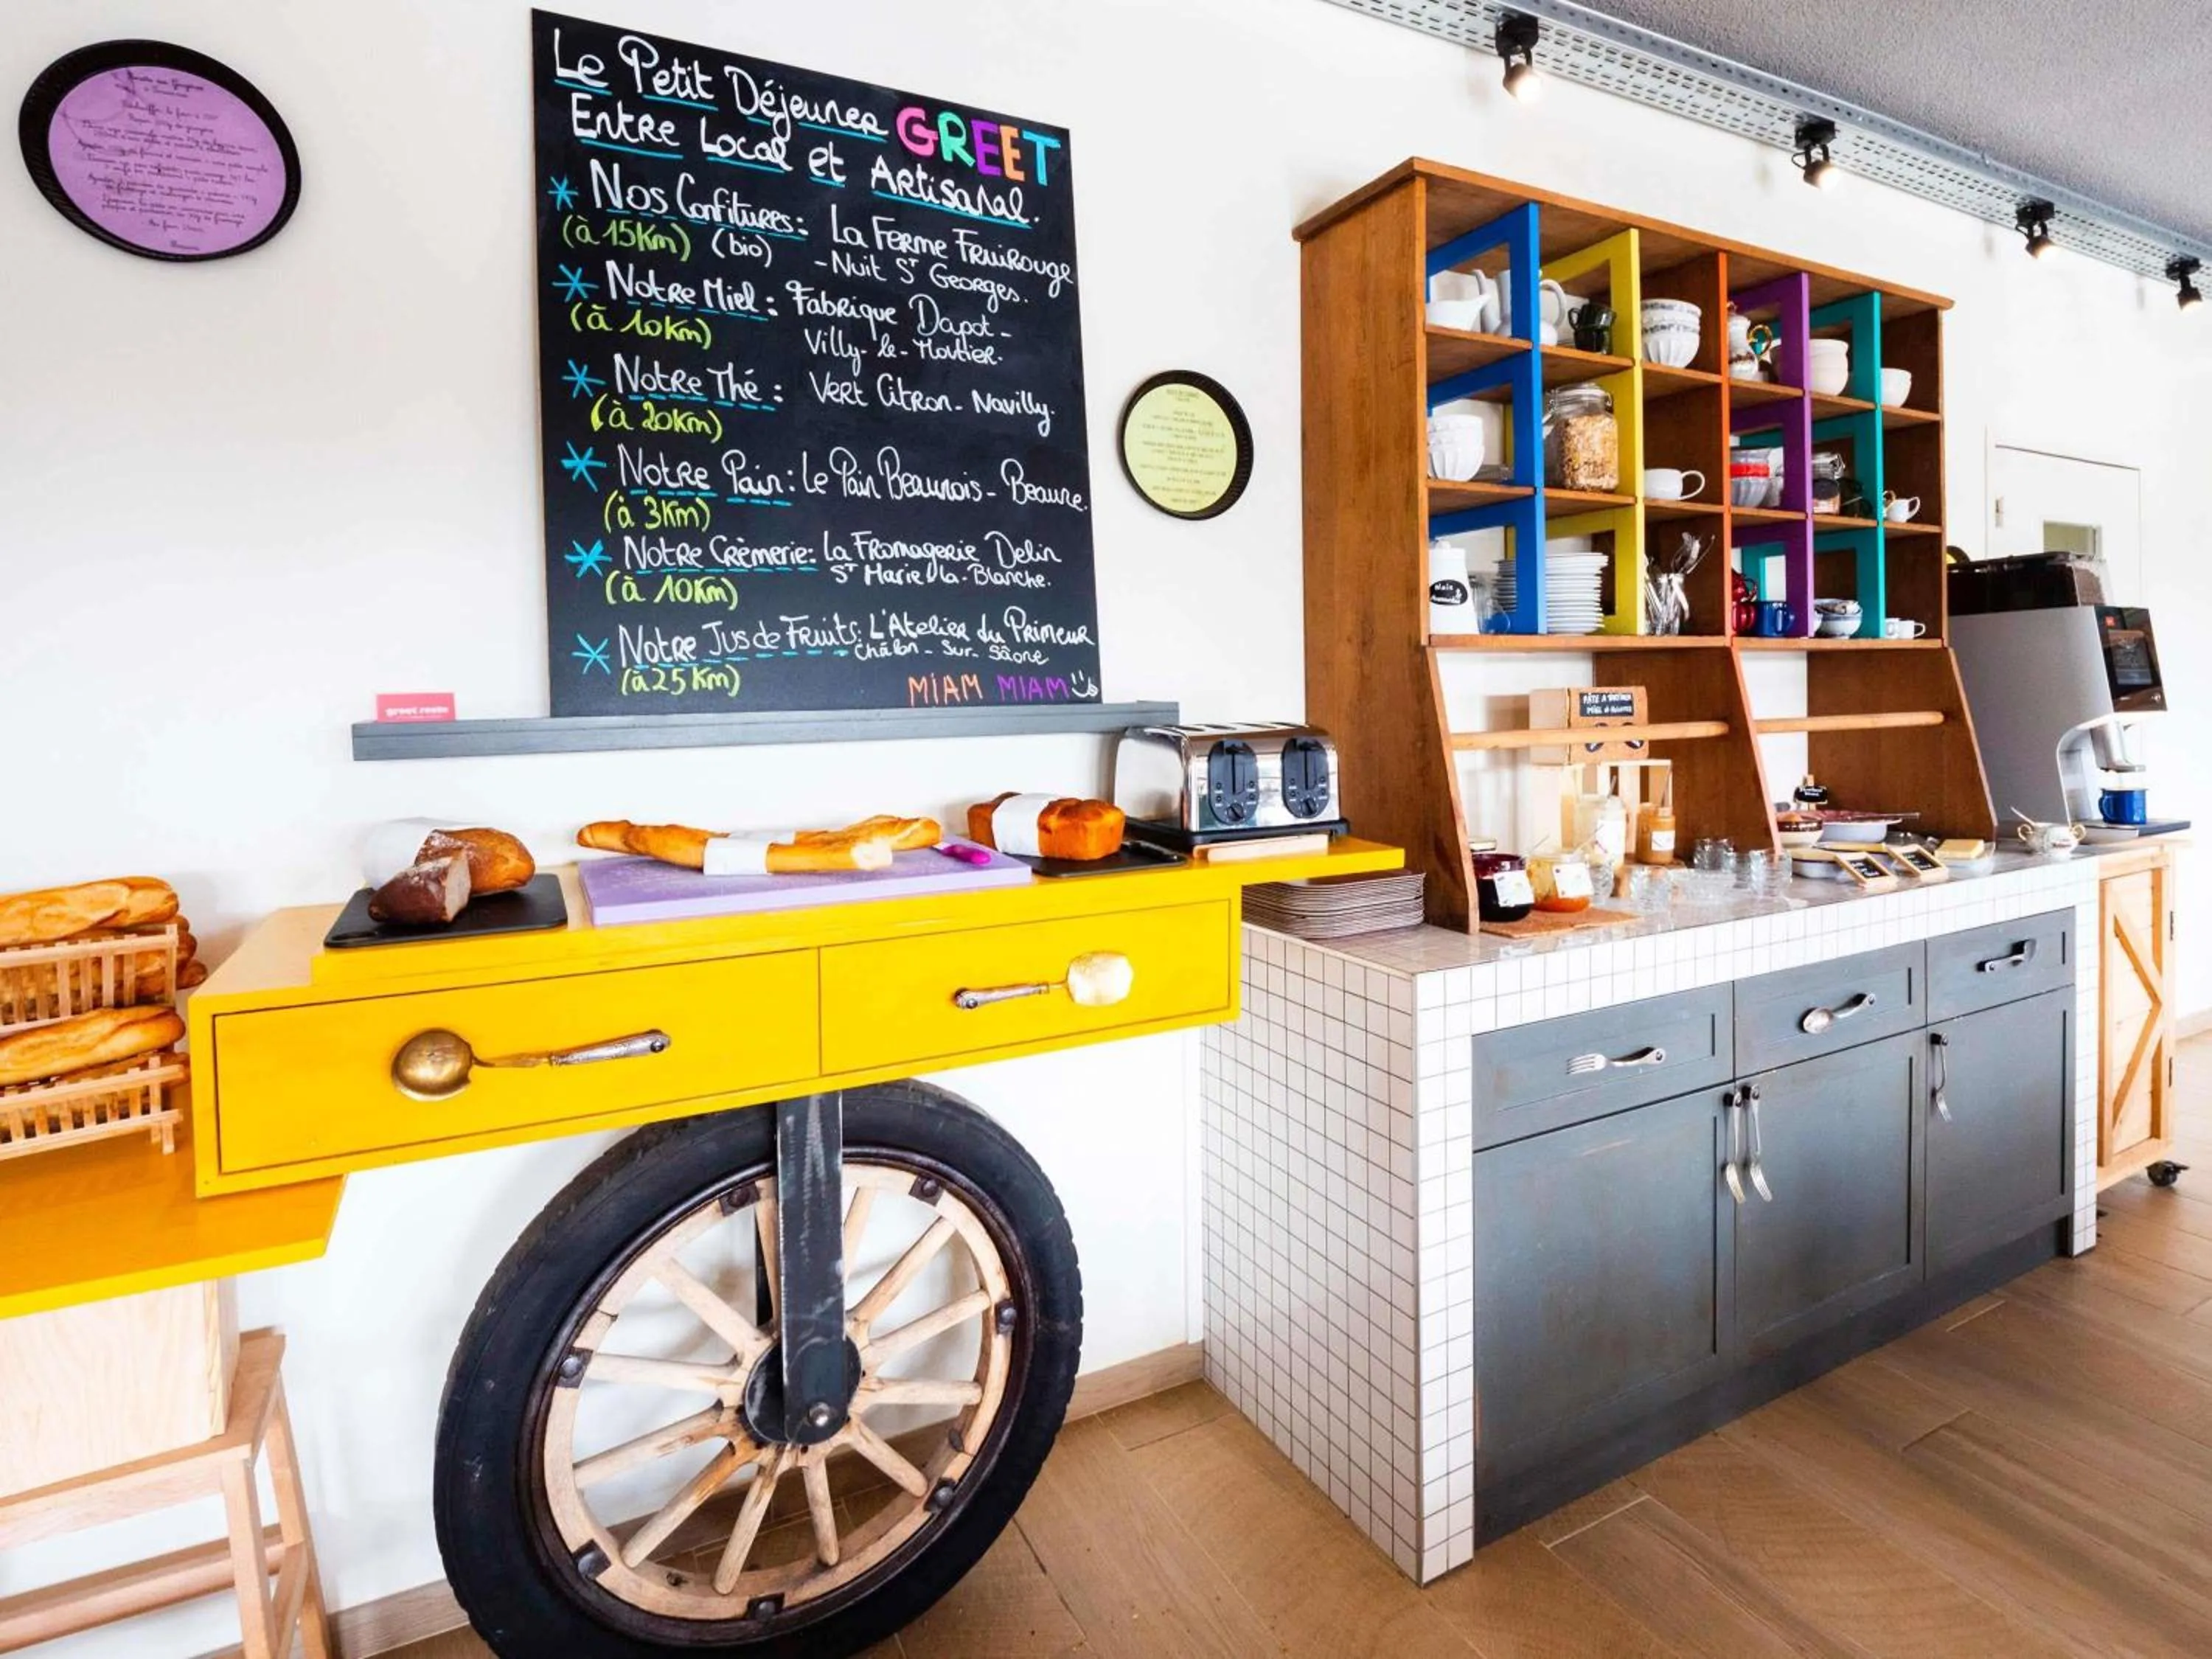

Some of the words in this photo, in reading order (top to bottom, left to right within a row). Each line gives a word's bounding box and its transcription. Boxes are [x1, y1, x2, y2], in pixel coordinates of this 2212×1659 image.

[554, 28, 609, 87] Le
[619, 36, 714, 99] Petit
[725, 64, 888, 142] Déjeuner
[897, 107, 1060, 186] GREET
[571, 93, 680, 146] Entre
[701, 116, 793, 171] Local
[808, 142, 846, 182] et
[590, 159, 668, 214] Nos
[832, 204, 869, 248] La
[872, 216, 947, 259] Ferme
[712, 228, 771, 268] (bio)
[605, 260, 696, 305] Notre
[785, 280, 898, 341] Fabrique
[613, 353, 703, 395] Notre
[810, 372, 869, 406] Vert
[618, 443, 711, 490] Notre
[829, 446, 881, 499] Pain
[1001, 458, 1088, 512] Beaune.
[623, 535, 704, 570] Notre
[824, 530, 852, 562] La
[851, 530, 980, 580] Fromagerie
[984, 530, 1062, 569] Delin
[865, 562, 924, 585] Marie
[619, 625, 697, 667] Notre
[702, 621, 750, 655] Jus
[753, 621, 781, 650] de
[870, 609, 970, 641] L'Atelier
[977, 613, 1005, 644] du
[1004, 605, 1094, 646] Primeur
[997, 674, 1069, 701] MIAM
